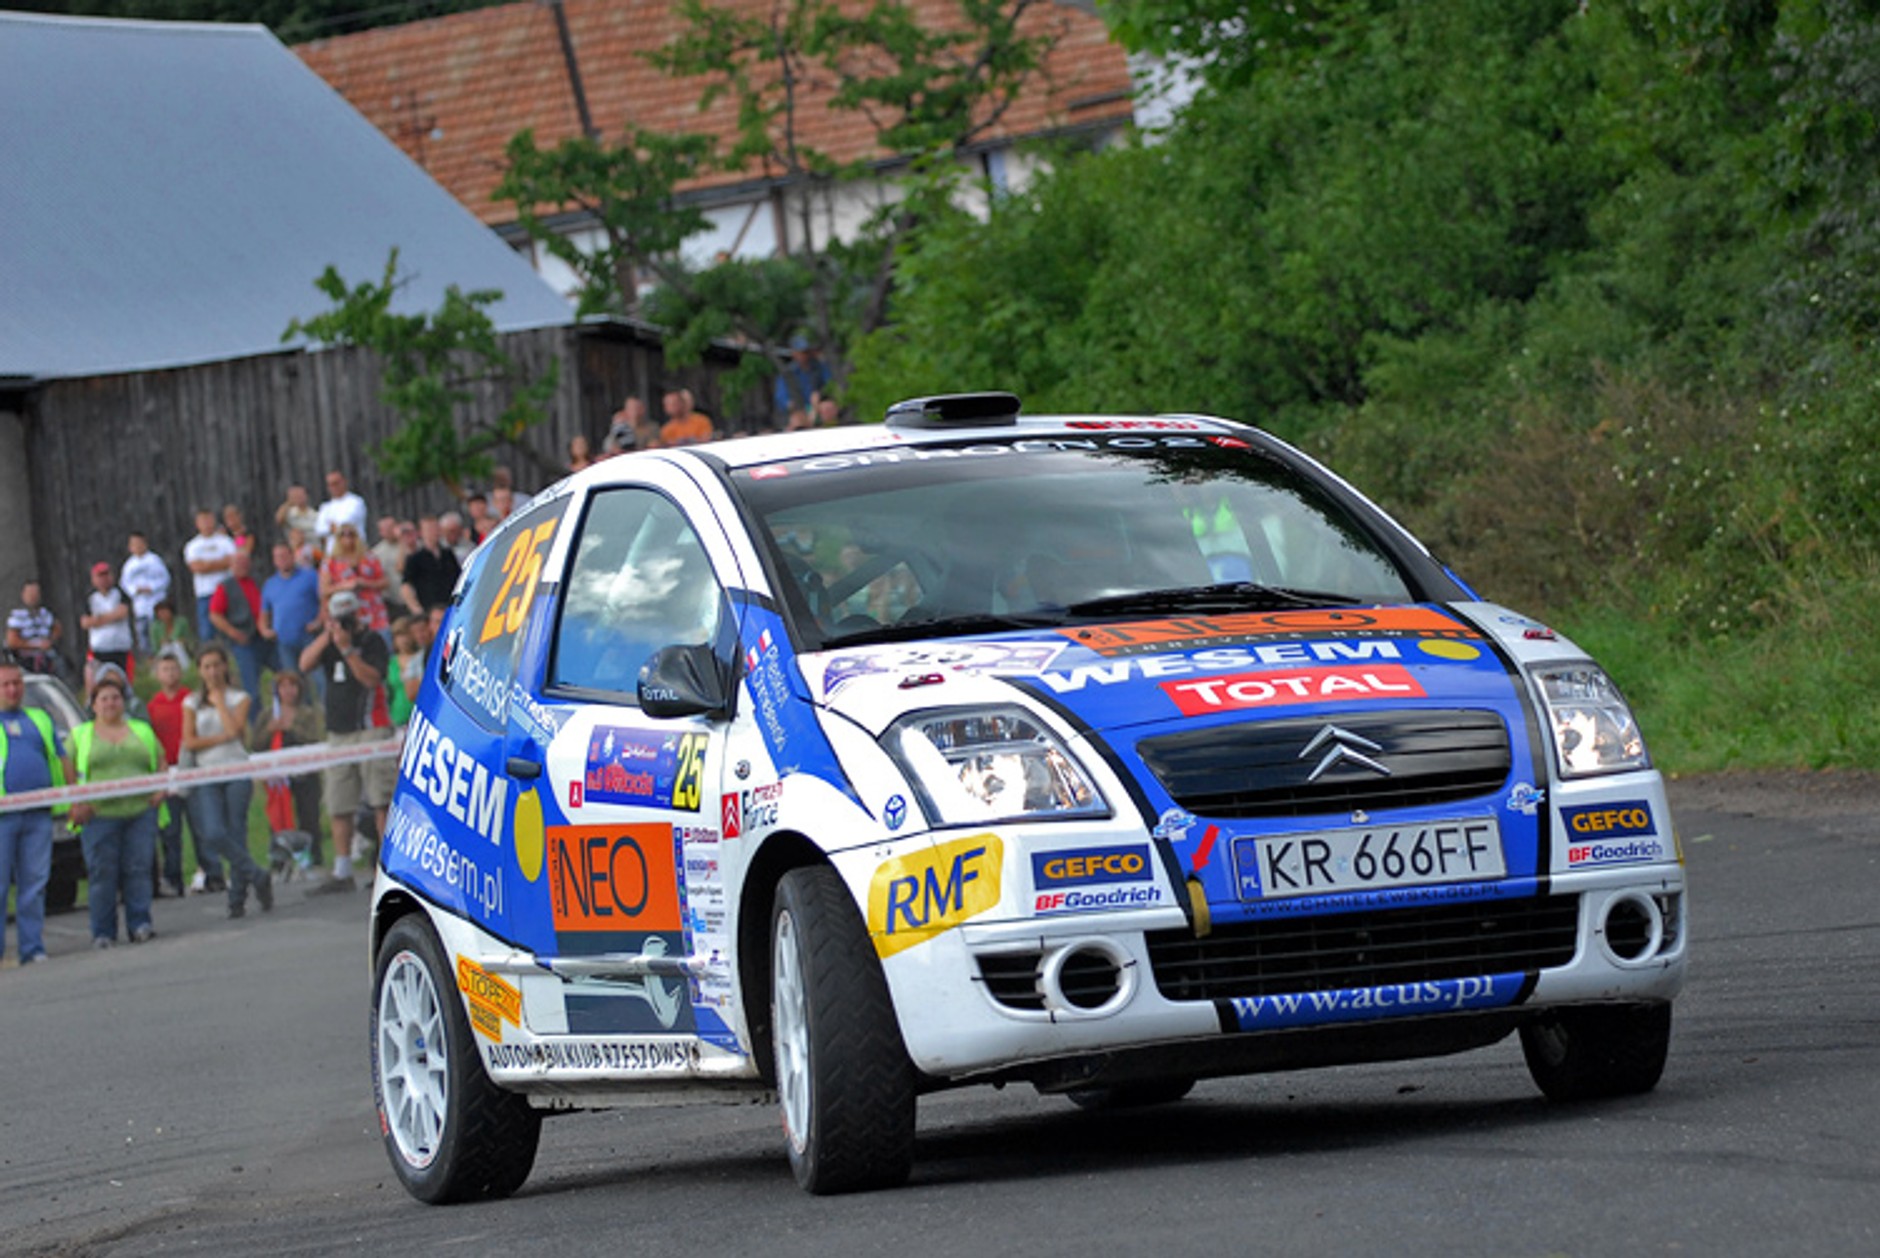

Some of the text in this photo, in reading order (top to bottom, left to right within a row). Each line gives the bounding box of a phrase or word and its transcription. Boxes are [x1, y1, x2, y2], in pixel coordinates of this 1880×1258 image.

[480, 518, 557, 643] 25
[1042, 640, 1402, 693] WESEM
[1176, 673, 1411, 706] TOTAL
[400, 704, 508, 846] WESEM
[672, 730, 708, 809] 25
[1572, 808, 1649, 832] GEFCO
[558, 836, 649, 918] NEO
[1043, 854, 1145, 879] GEFCO
[1266, 824, 1490, 890] KR 666FF
[1569, 843, 1664, 863] BFGoodrich
[886, 846, 987, 935] RMF
[1035, 884, 1162, 911] BFGoodrich
[1242, 876, 1259, 889] PL
